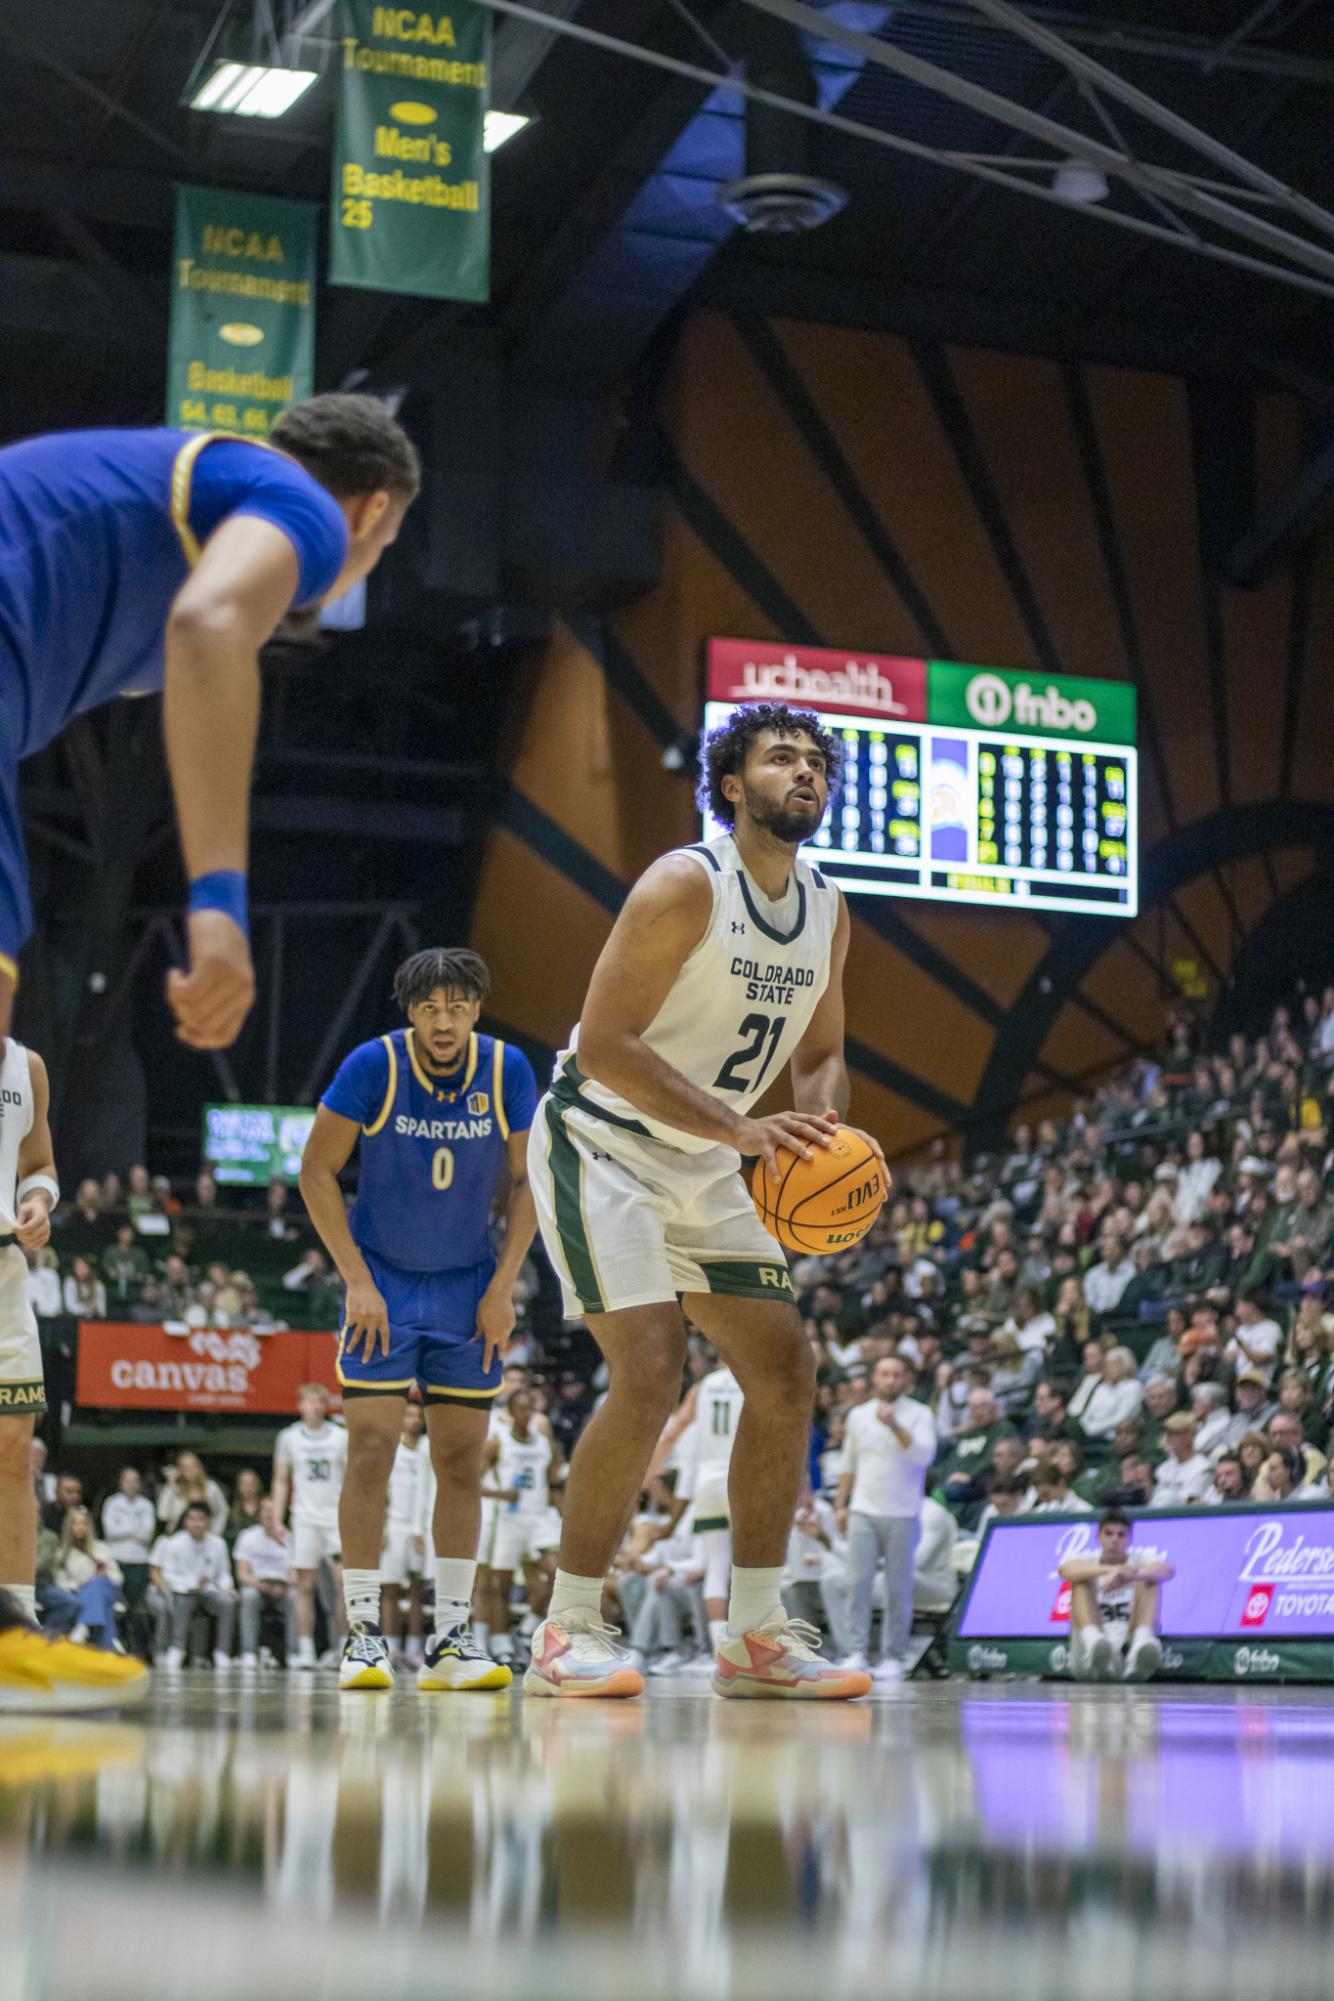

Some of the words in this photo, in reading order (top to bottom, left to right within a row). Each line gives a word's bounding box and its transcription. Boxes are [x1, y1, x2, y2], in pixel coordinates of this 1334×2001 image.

[372, 6, 456, 47] NCAA
[342, 38, 487, 88] Tournament
[375, 126, 452, 167] Men's
[342, 163, 479, 212] Basketball
[202, 224, 284, 262] NCAA
[178, 258, 310, 304] Tournament
[187, 360, 293, 401] Basketball
[744, 654, 893, 706] uchealth
[1014, 682, 1097, 731] fnbo
[730, 957, 814, 987] COLORADO
[745, 982, 794, 1005] STATE
[712, 1012, 787, 1093] 21
[395, 1115, 493, 1139] SPARTANS
[432, 1147, 454, 1191] 0
[111, 1359, 249, 1393] canvas
[711, 1400, 730, 1435] 11
[306, 1459, 330, 1482] 30
